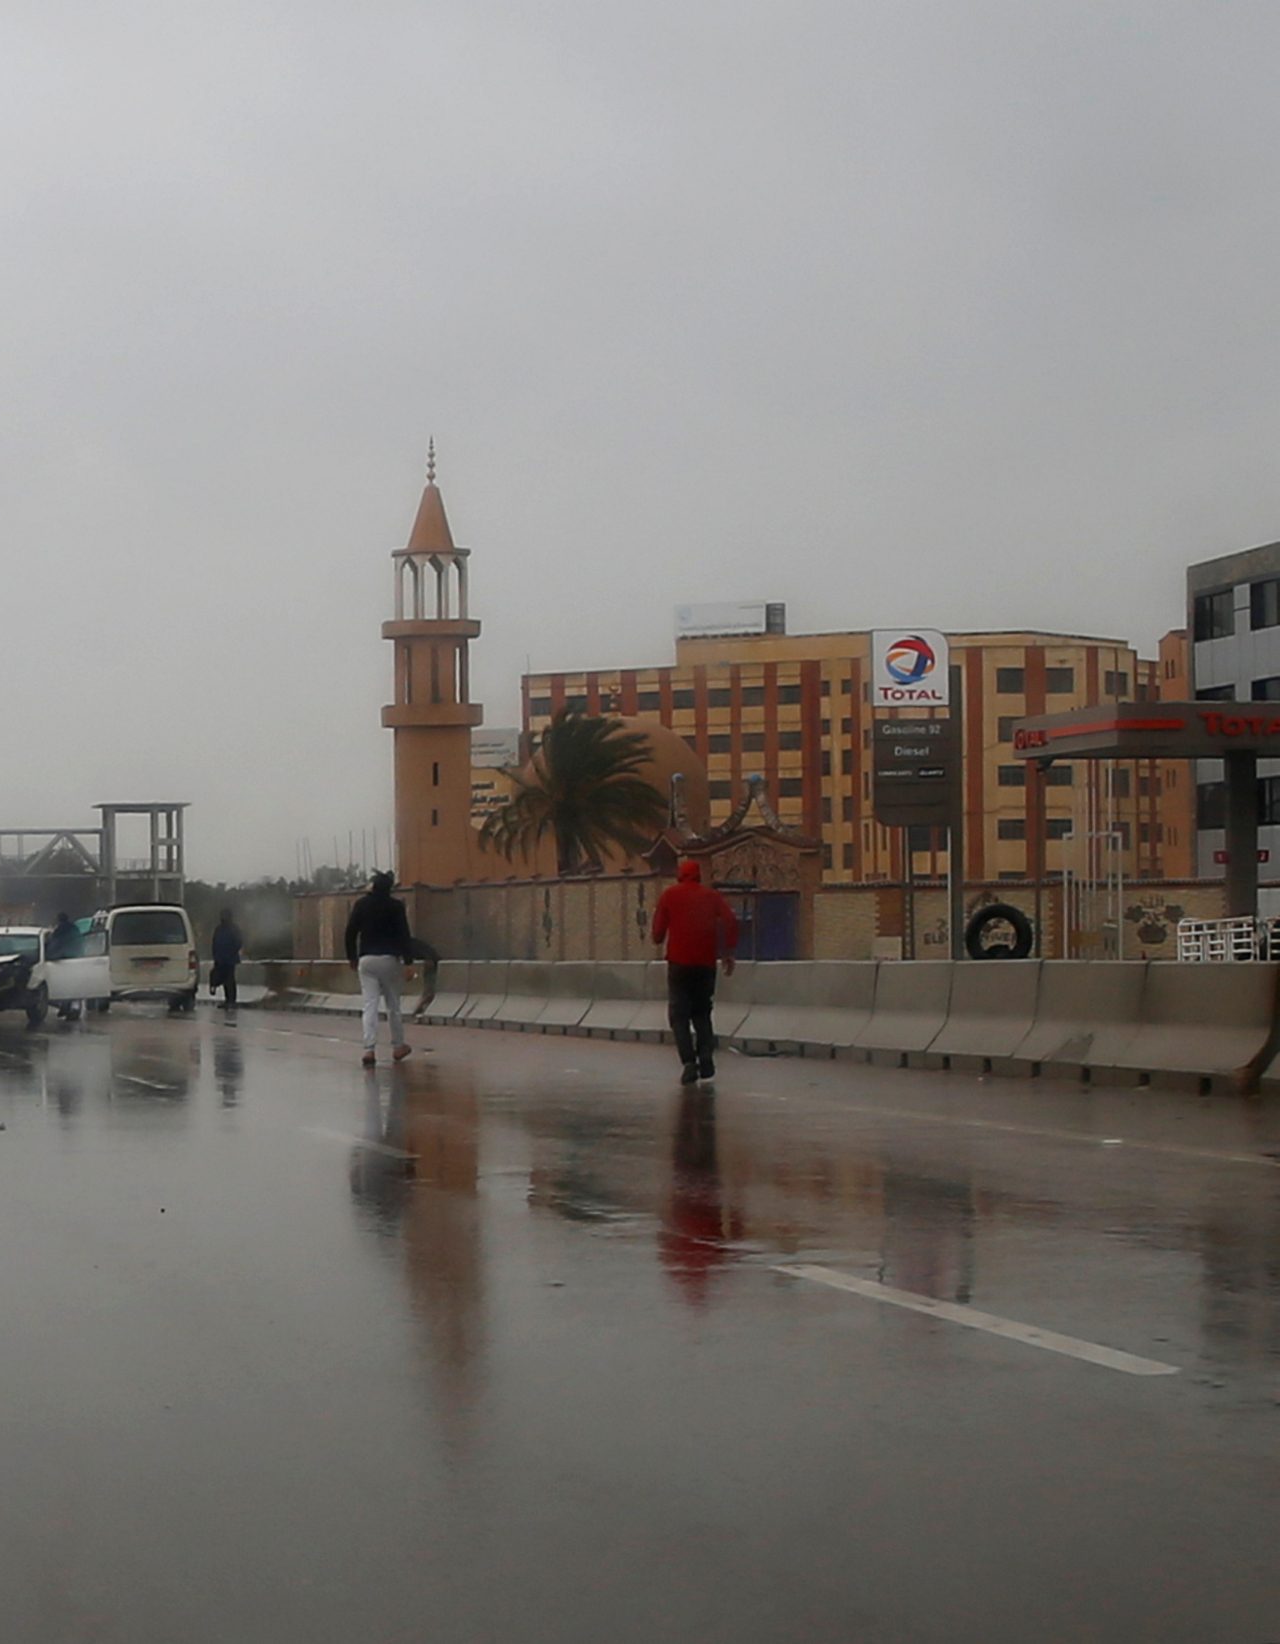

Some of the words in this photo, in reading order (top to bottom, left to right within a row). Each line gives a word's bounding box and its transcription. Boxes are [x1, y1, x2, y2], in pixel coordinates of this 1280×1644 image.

[878, 686, 943, 701] TOTAL
[882, 724, 926, 735] Gasoline
[1199, 711, 1280, 736] TOTA
[894, 745, 930, 757] Diesel
